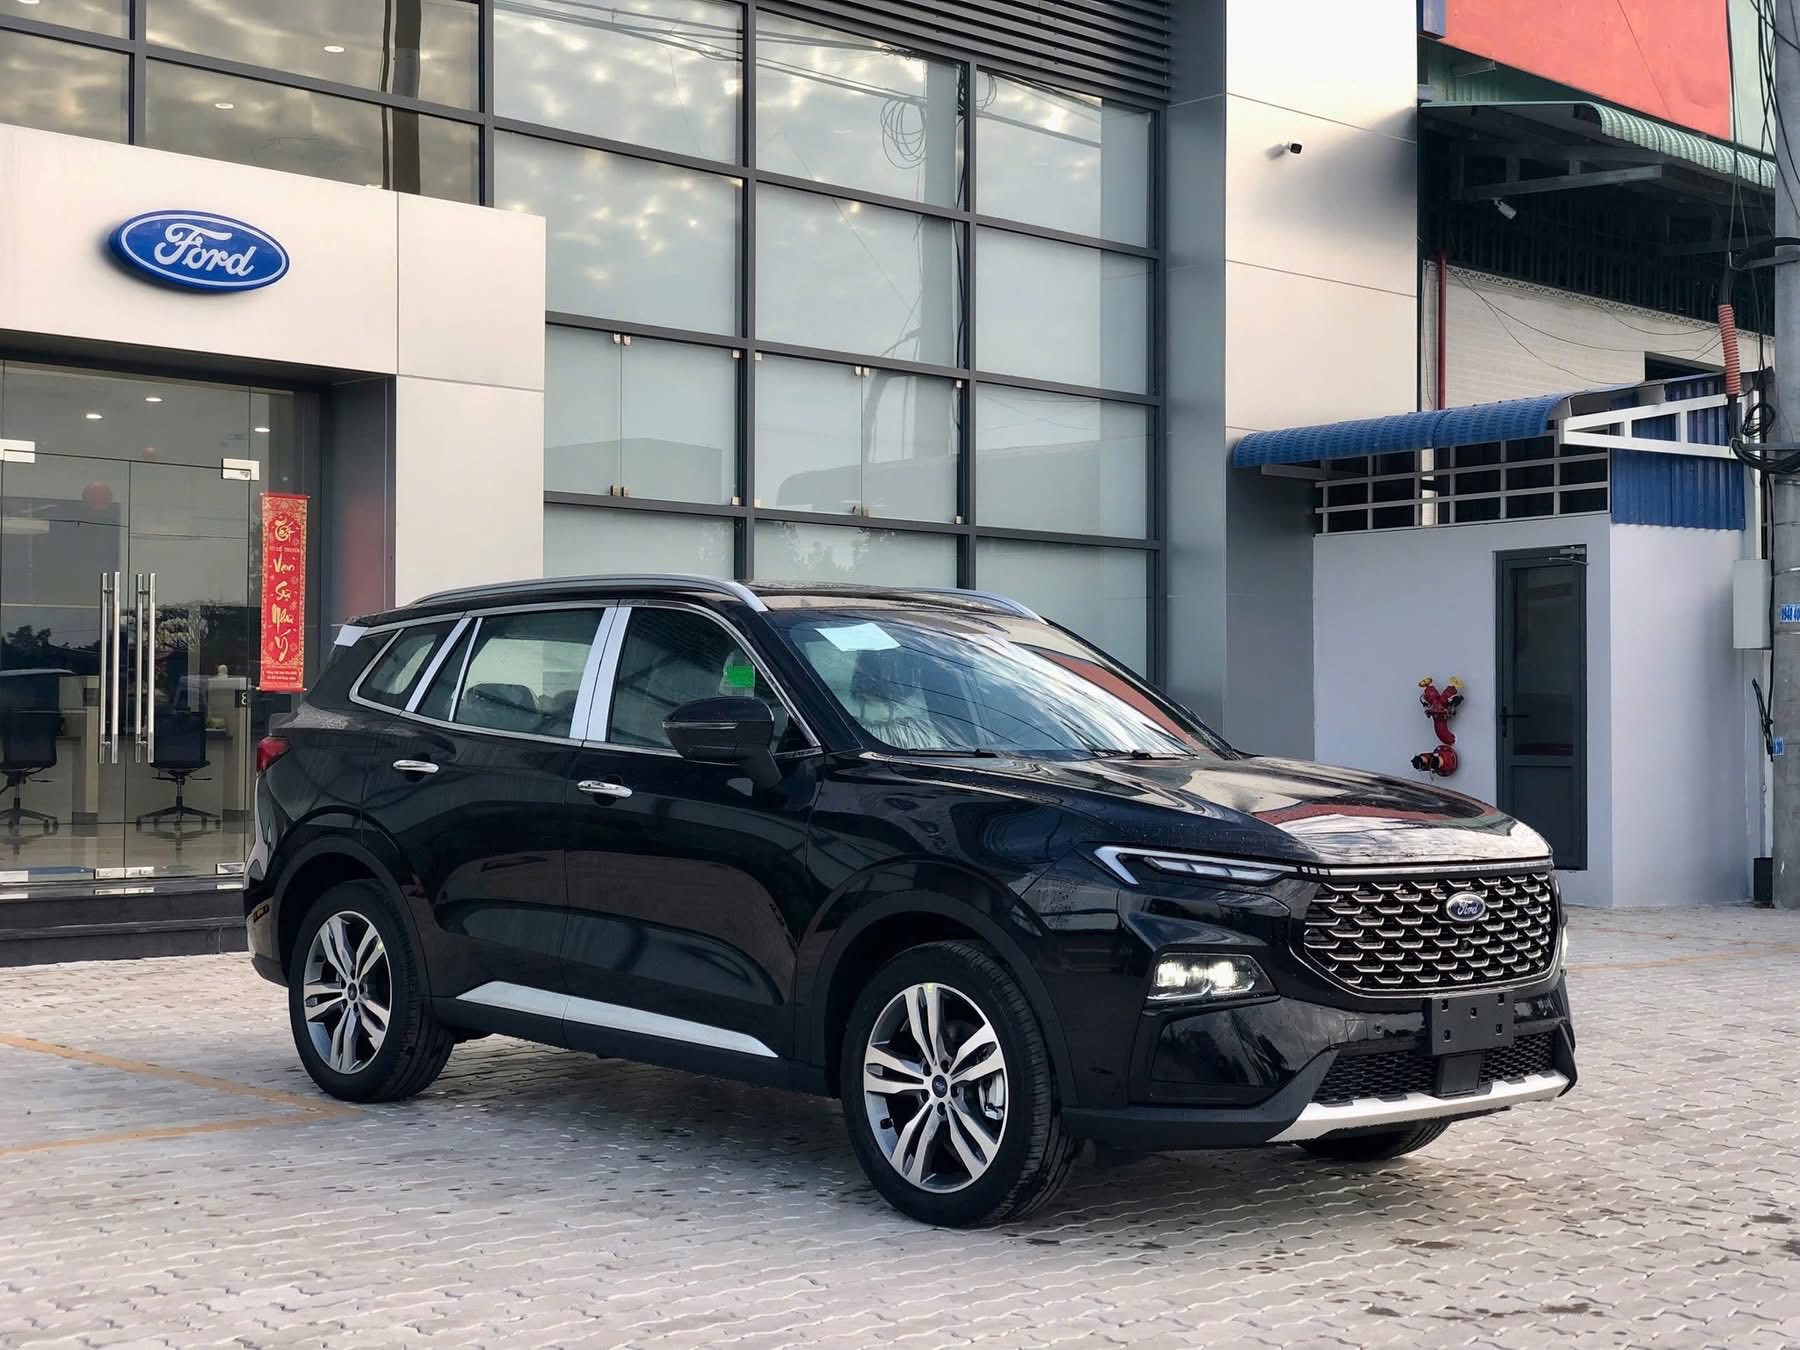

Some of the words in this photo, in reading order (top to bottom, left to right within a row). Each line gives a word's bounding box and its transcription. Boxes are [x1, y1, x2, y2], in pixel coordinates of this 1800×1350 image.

[154, 223, 256, 277] Ford
[273, 552, 295, 574] Vạn
[271, 603, 294, 634] Như
[274, 629, 291, 662] Ý
[1457, 900, 1479, 915] Ford
